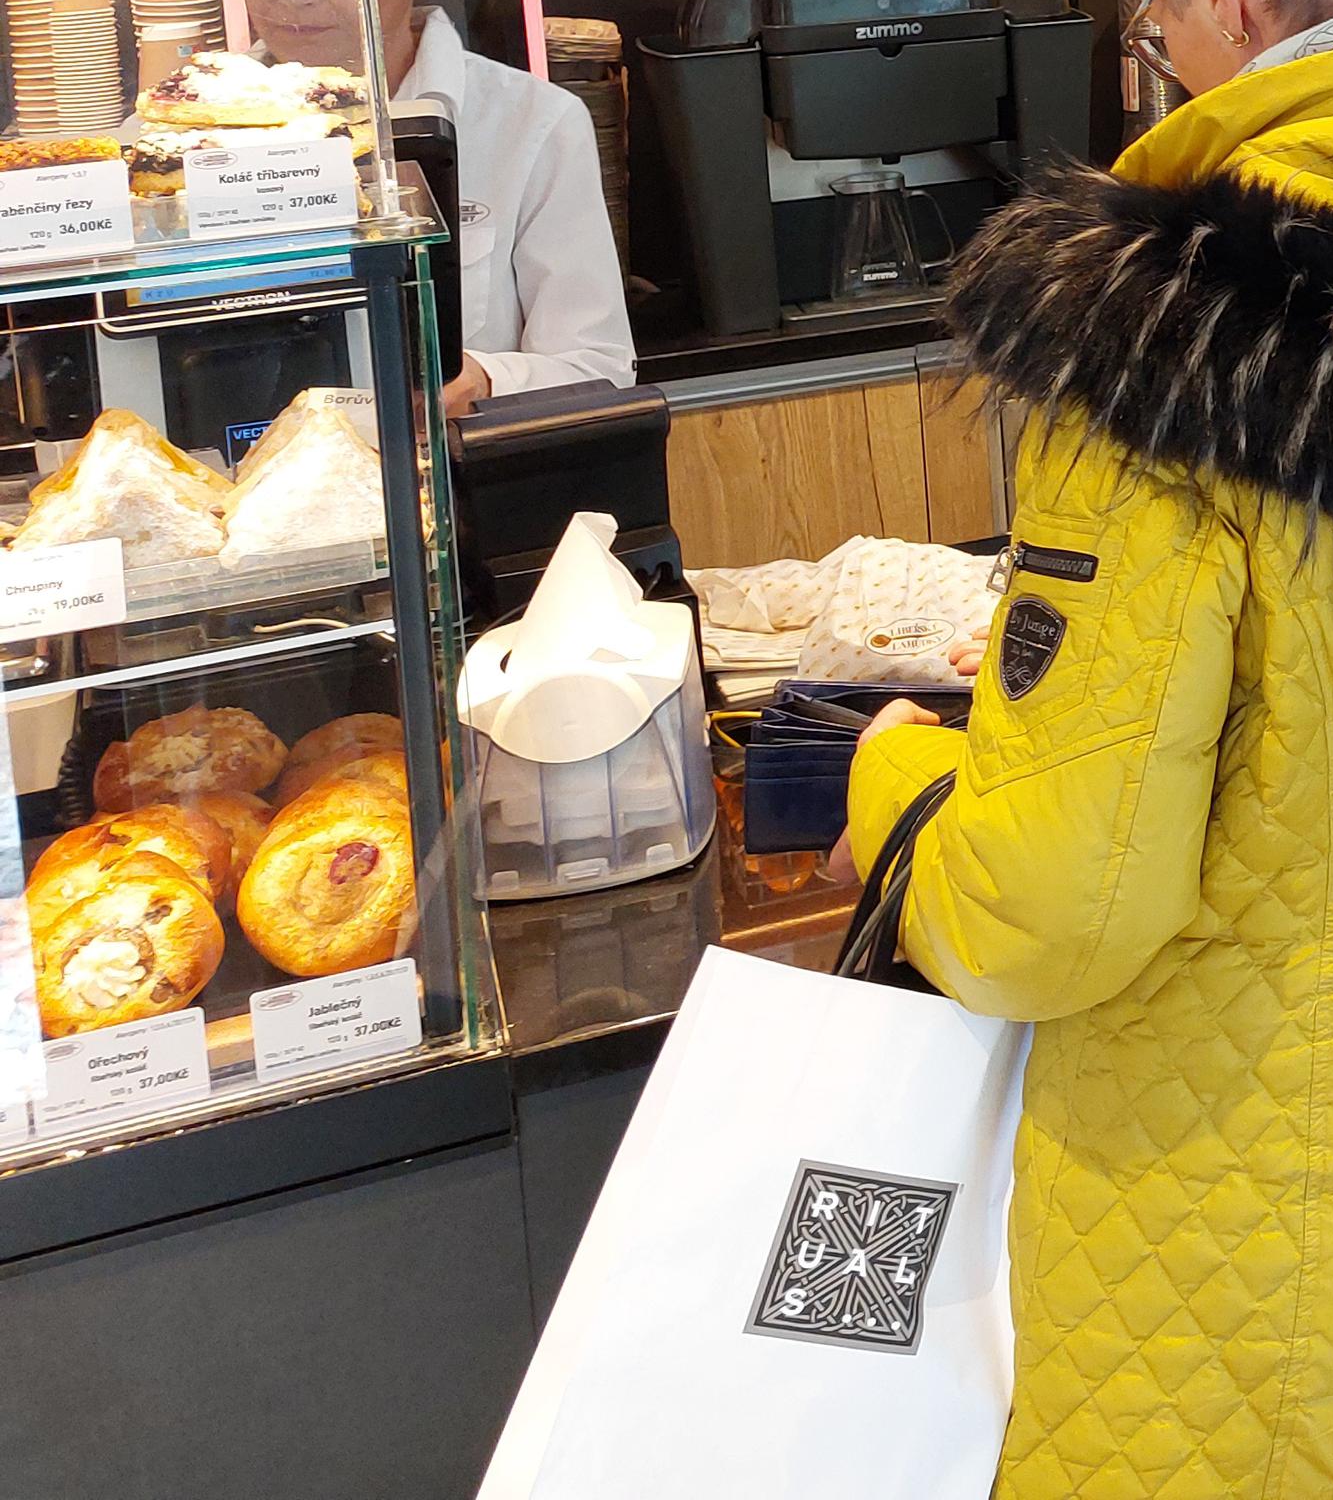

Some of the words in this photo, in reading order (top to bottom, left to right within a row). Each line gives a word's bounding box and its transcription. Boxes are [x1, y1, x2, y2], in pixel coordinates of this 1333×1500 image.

[855, 22, 923, 39] zummo
[218, 171, 253, 184] Koláč
[0, 201, 61, 218] aběnčiny
[65, 199, 94, 211] řezy
[289, 194, 338, 209] 37,00Kč
[59, 218, 113, 235] 36,00Kč
[323, 394, 375, 405] Borův
[5, 580, 64, 596] Chrupiny
[53, 592, 105, 610] 19,00Kč
[308, 995, 363, 1018] Jablečný
[354, 1016, 402, 1037] 37,00Kč
[88, 1046, 149, 1069] Ořechový
[139, 1067, 190, 1089] 37,00Kč
